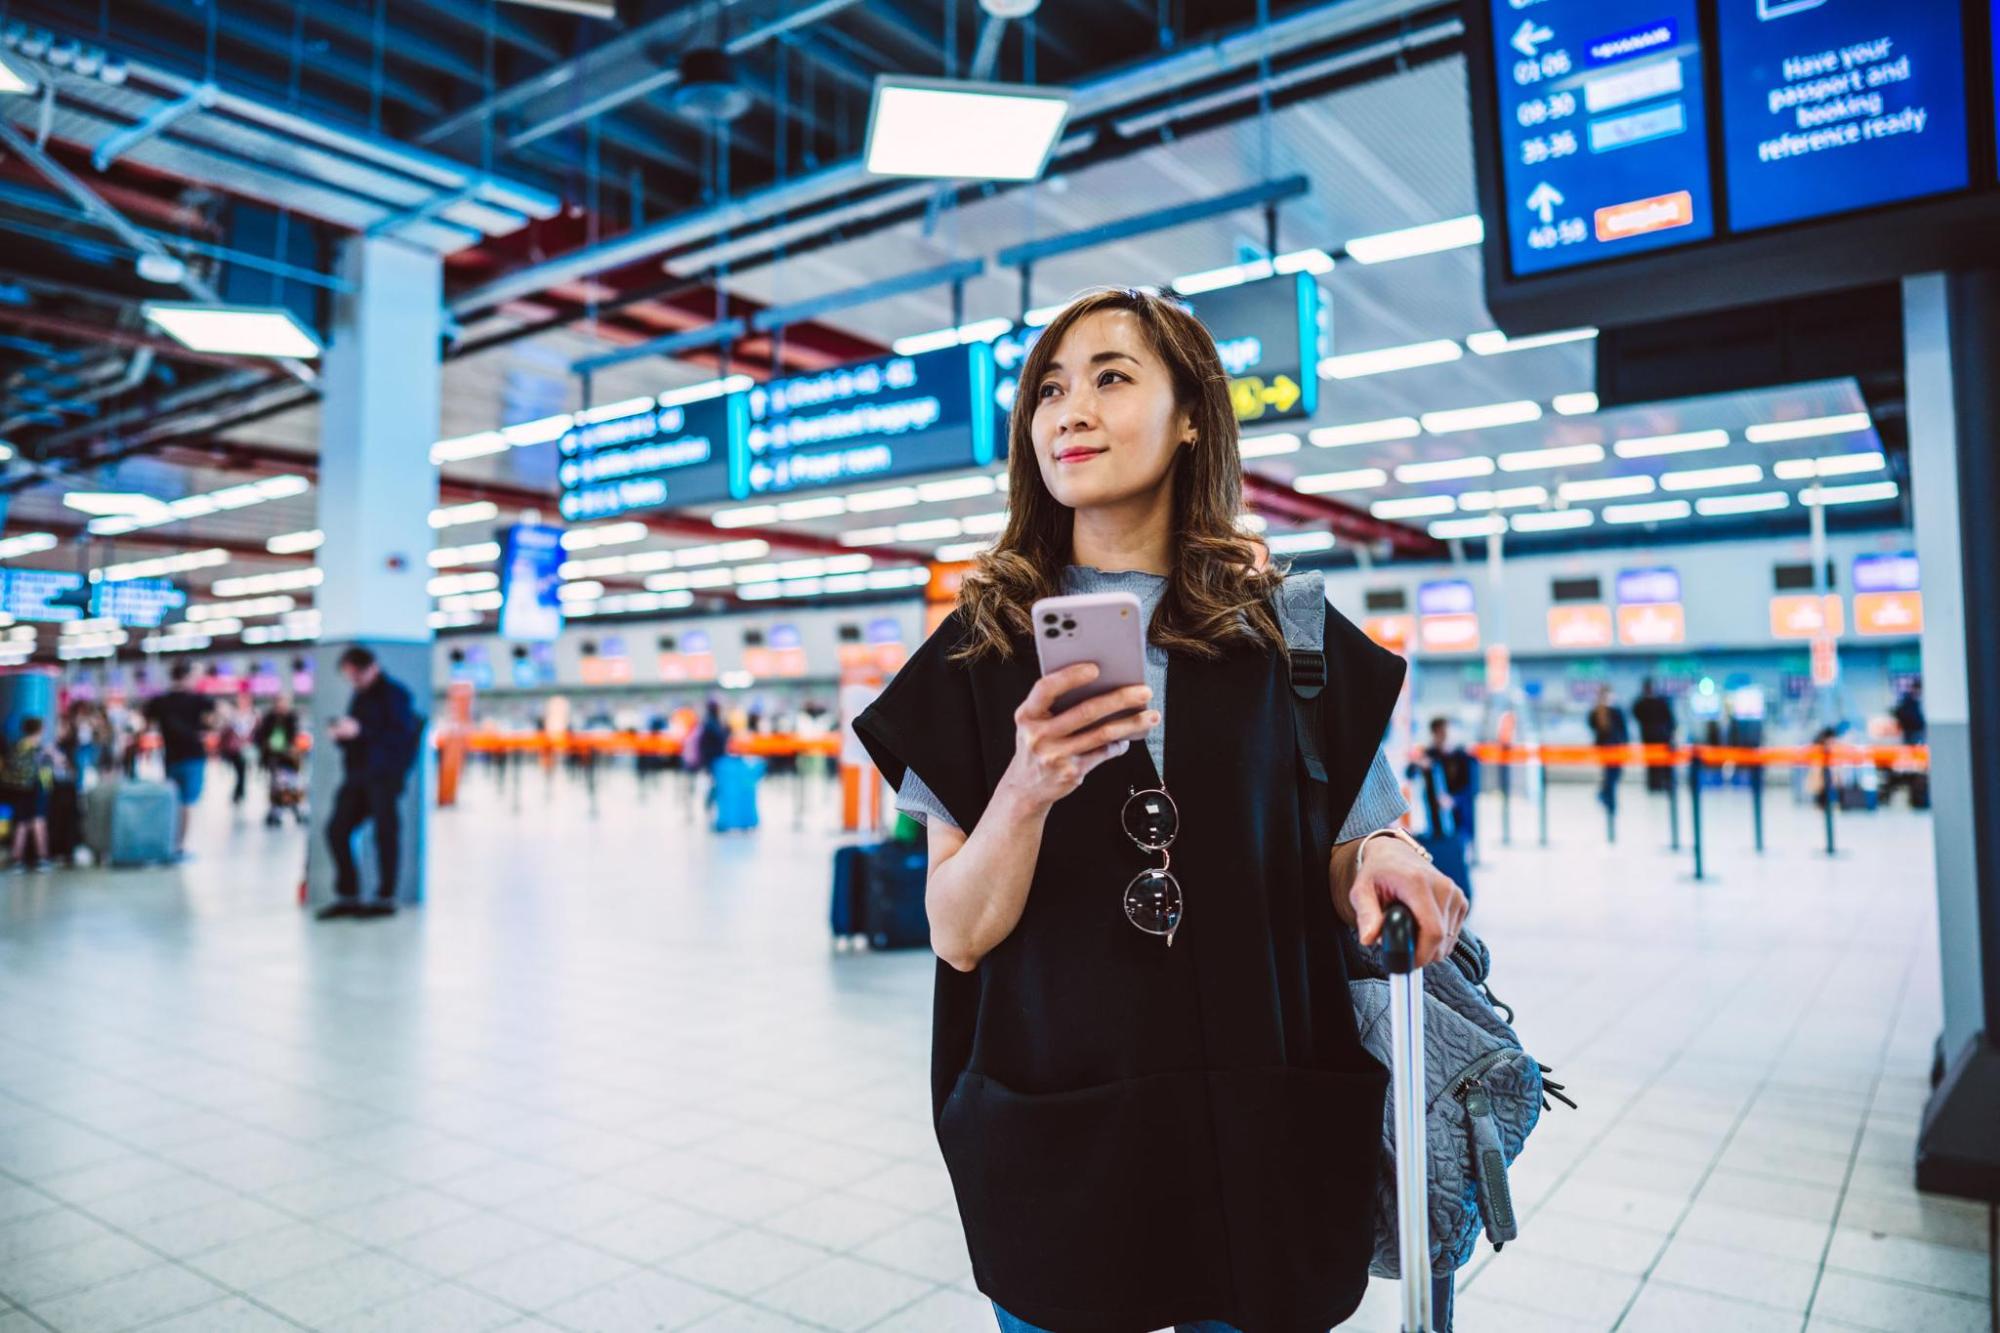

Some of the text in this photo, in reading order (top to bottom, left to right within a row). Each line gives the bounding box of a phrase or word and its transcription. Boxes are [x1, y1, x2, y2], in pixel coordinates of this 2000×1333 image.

[1783, 36, 1893, 81] Have your
[1768, 54, 1910, 114] passport and
[1758, 106, 1927, 162] reference ready
[1796, 91, 1883, 128] booking
